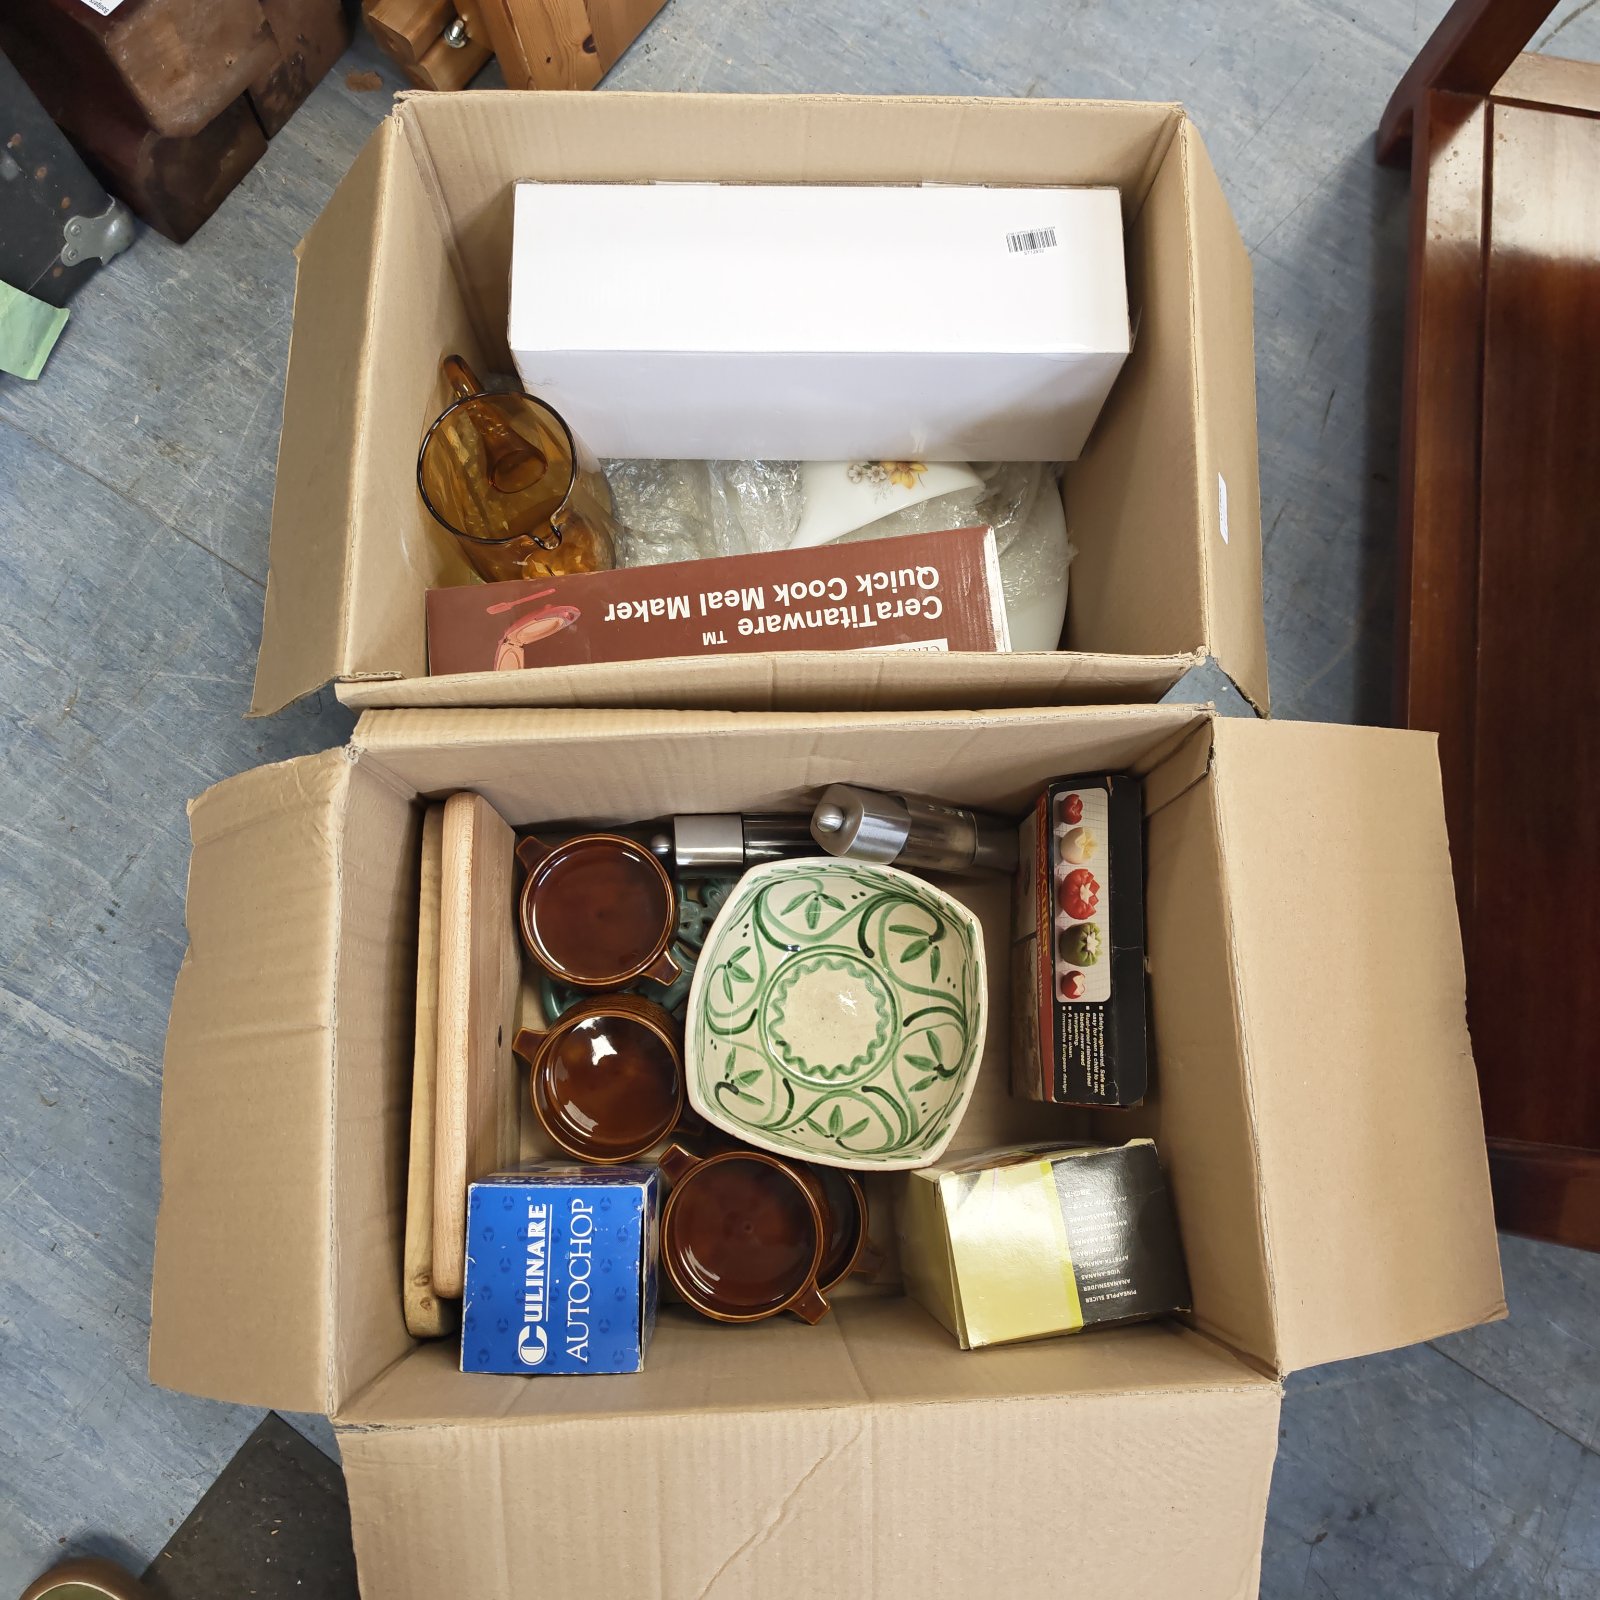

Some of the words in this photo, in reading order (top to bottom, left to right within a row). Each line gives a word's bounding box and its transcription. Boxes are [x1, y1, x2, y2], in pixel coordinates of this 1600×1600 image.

[774, 577, 847, 607] Cook
[855, 566, 940, 597] Quick
[604, 596, 690, 623] Maker
[701, 586, 765, 616] Meal
[737, 596, 943, 636] CeraTitanware
[518, 1203, 547, 1366] CULINARE
[566, 1198, 593, 1363] AUTOCHOP
[1106, 1290, 1137, 1299] PINEAPPLE
[1085, 1295, 1105, 1303] SLICER
